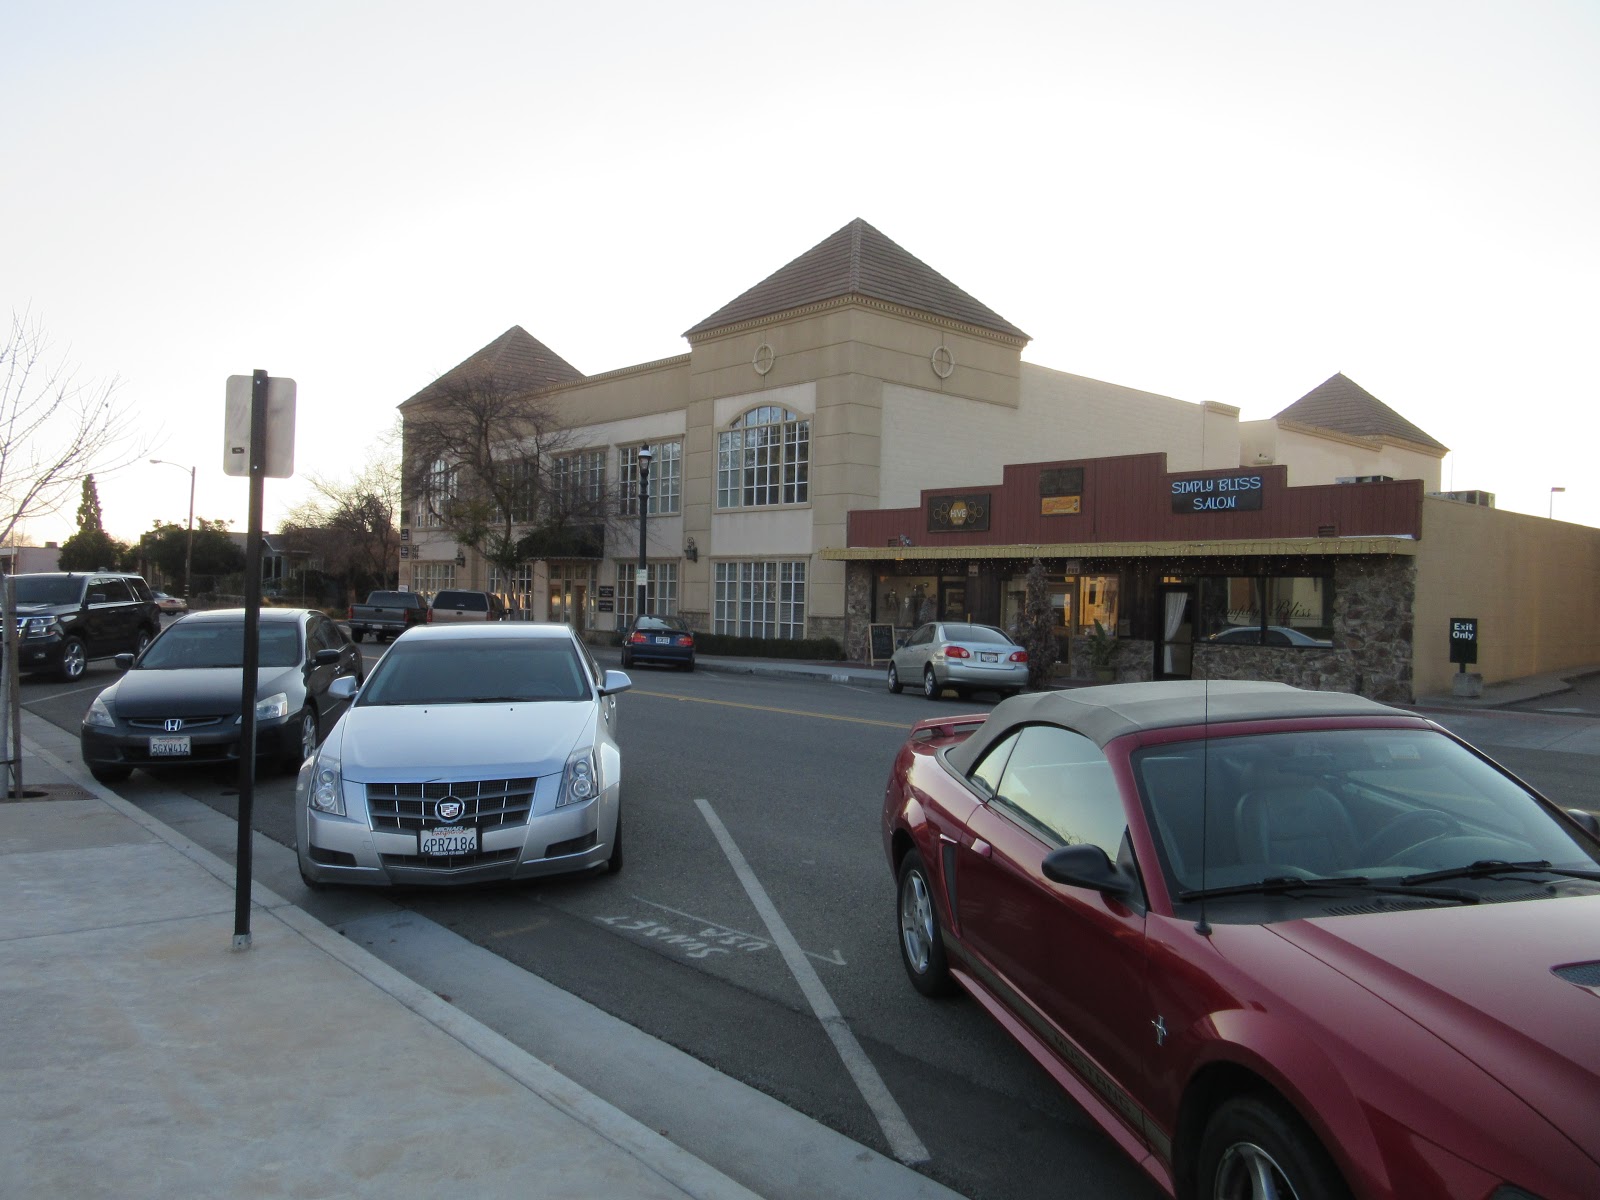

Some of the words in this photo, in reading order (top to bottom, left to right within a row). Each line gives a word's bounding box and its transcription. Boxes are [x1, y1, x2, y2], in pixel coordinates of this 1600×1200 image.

[1171, 480, 1214, 494] SIMPLY
[1217, 476, 1262, 492] BLISS
[1193, 495, 1236, 510] SALON
[950, 508, 967, 518] HIVE
[1275, 600, 1312, 618] Bliss
[1453, 622, 1473, 631] Exit
[1452, 630, 1474, 640] Only
[423, 837, 475, 852] 6PRZ186
